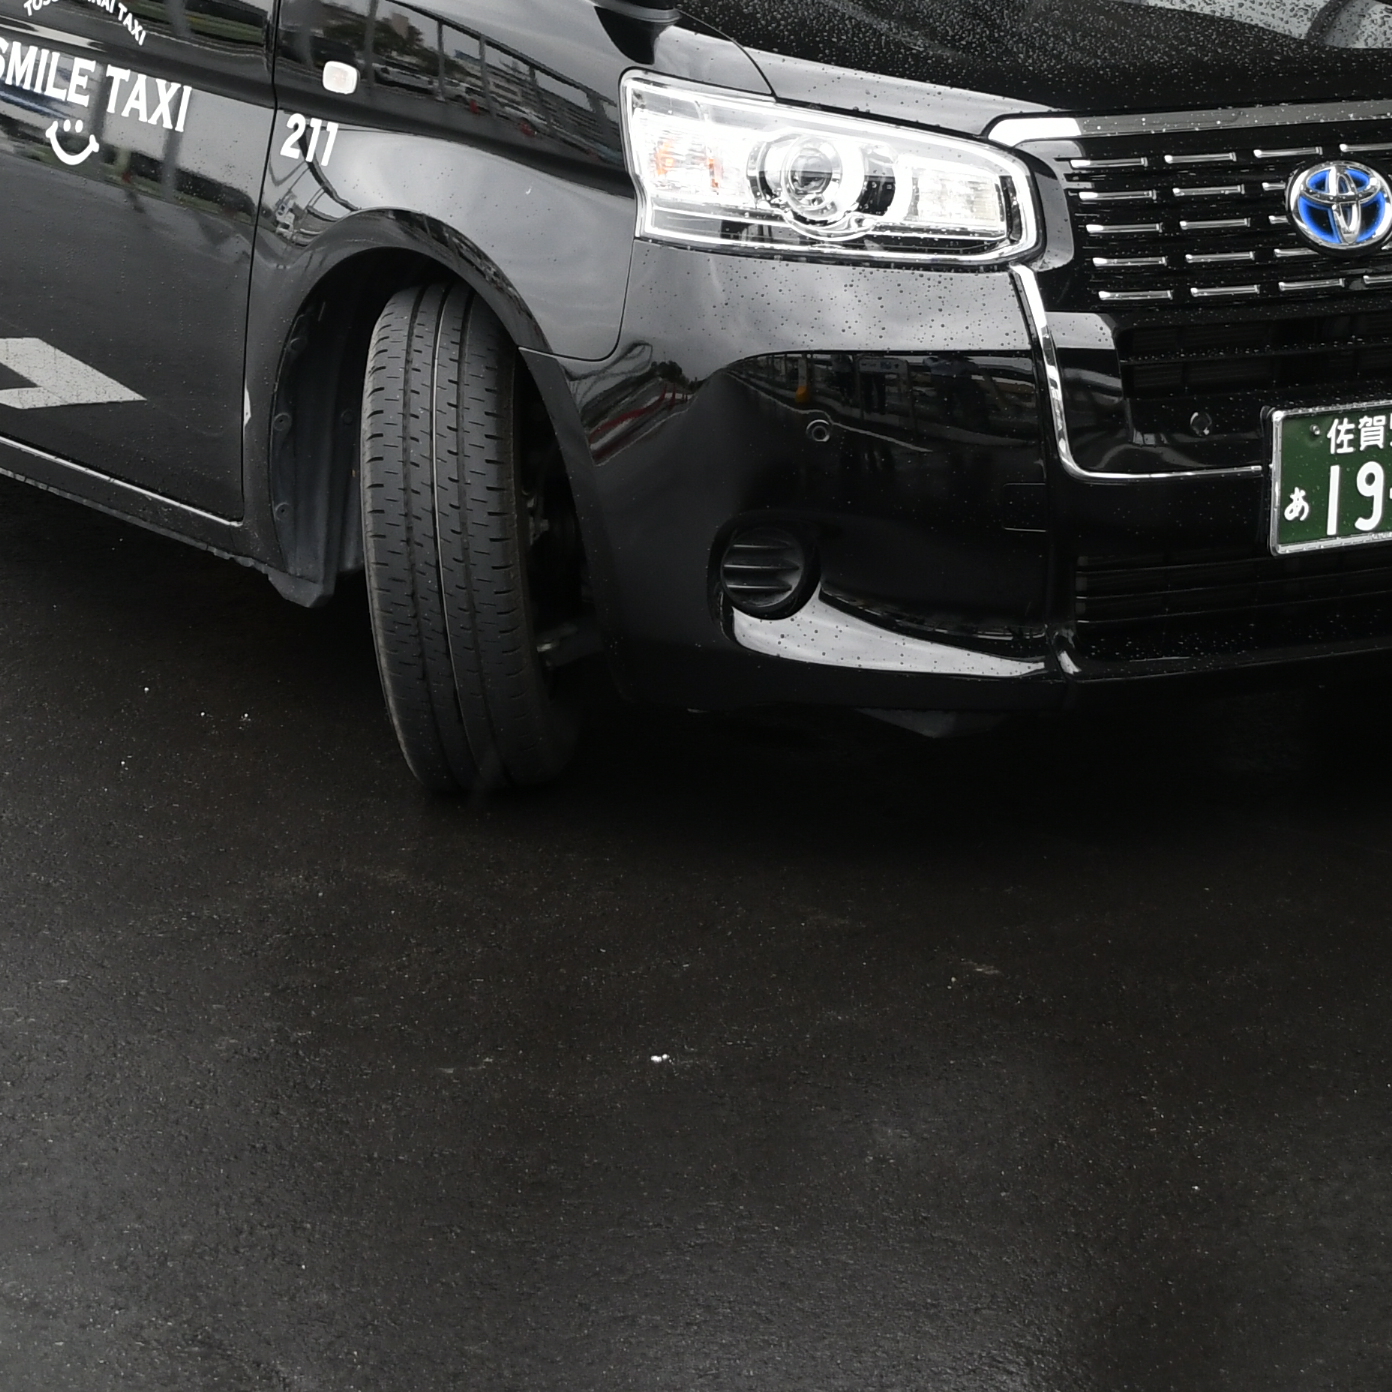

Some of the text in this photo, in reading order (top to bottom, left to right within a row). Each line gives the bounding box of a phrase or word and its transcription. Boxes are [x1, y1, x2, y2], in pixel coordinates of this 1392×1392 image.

[117, 2, 148, 46] TAXI
[105, 63, 193, 133] TAXI
[280, 113, 339, 167] 211
[1284, 486, 1310, 522] あ
